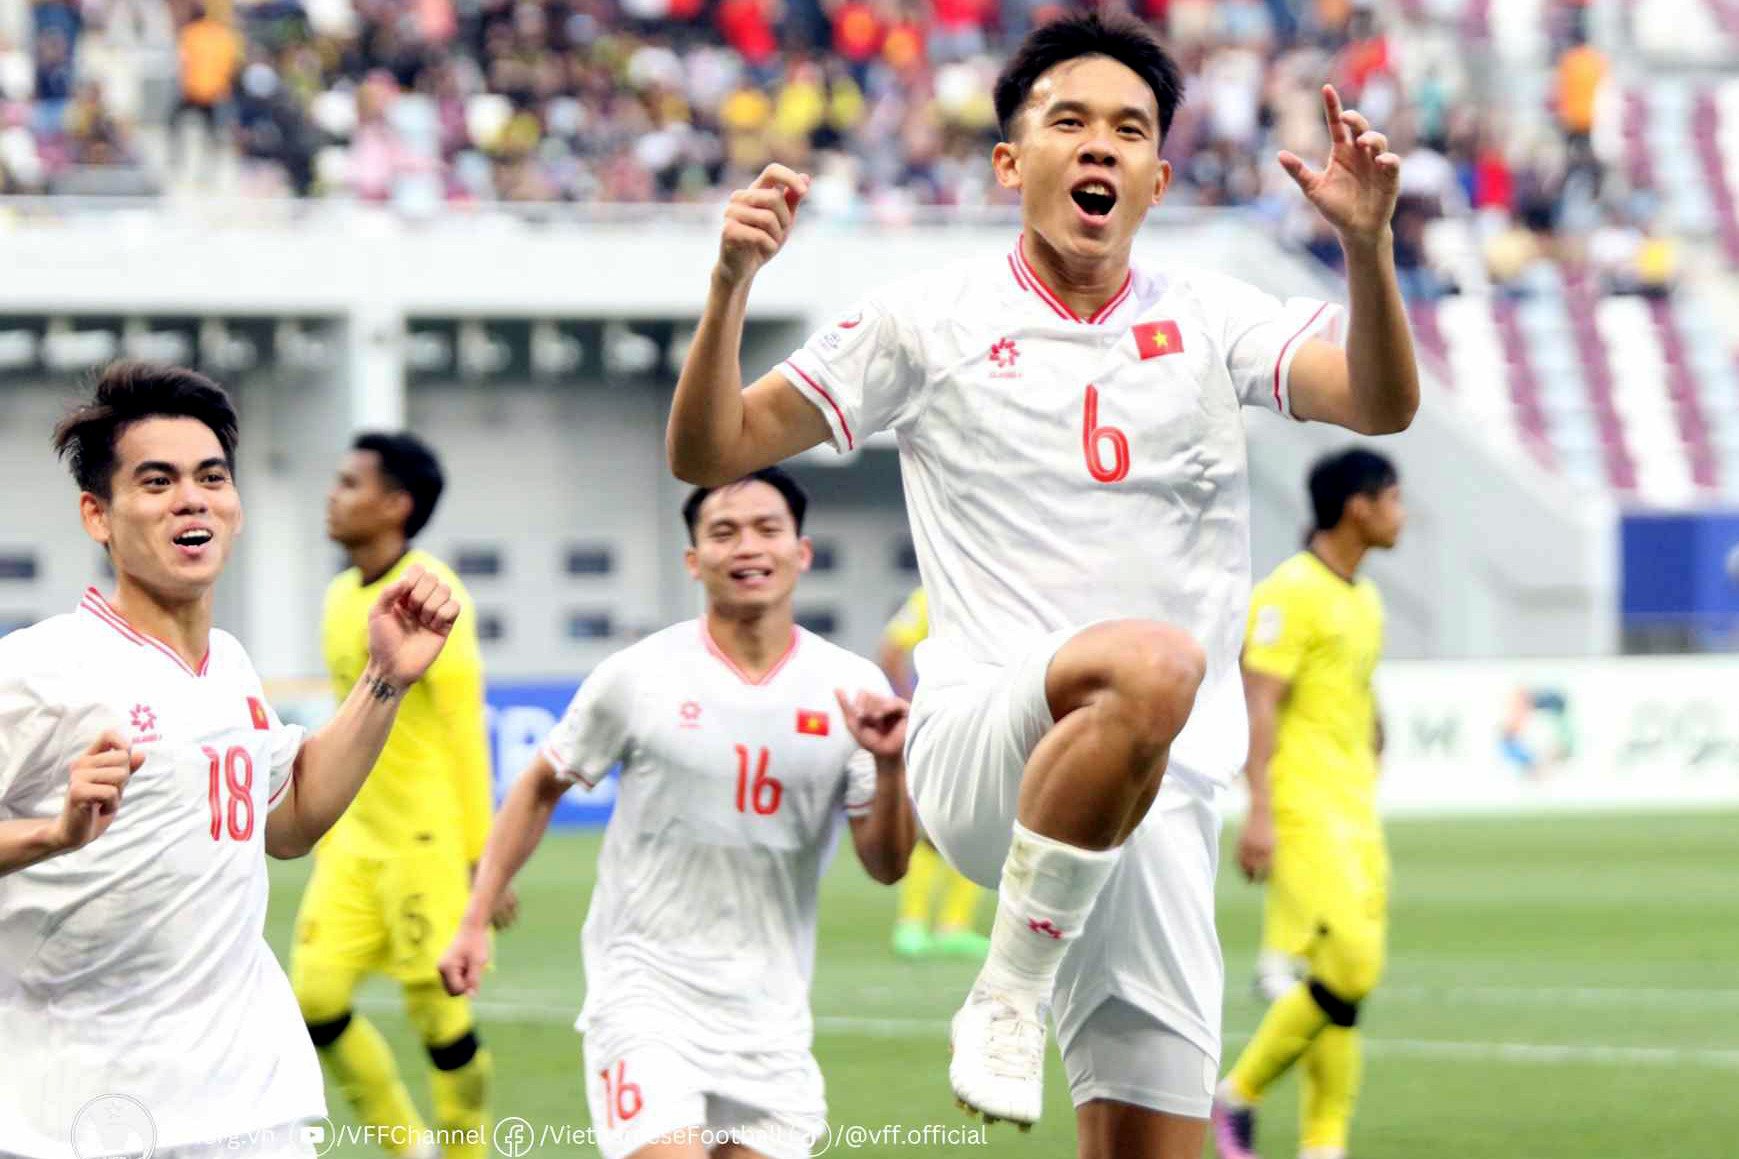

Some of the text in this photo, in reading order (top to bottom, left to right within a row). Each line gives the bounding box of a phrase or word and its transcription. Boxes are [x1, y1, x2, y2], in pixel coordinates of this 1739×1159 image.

[1083, 384, 1131, 482] 6
[202, 745, 254, 841] 18
[735, 744, 782, 815] 16
[599, 1058, 642, 1129] 16
